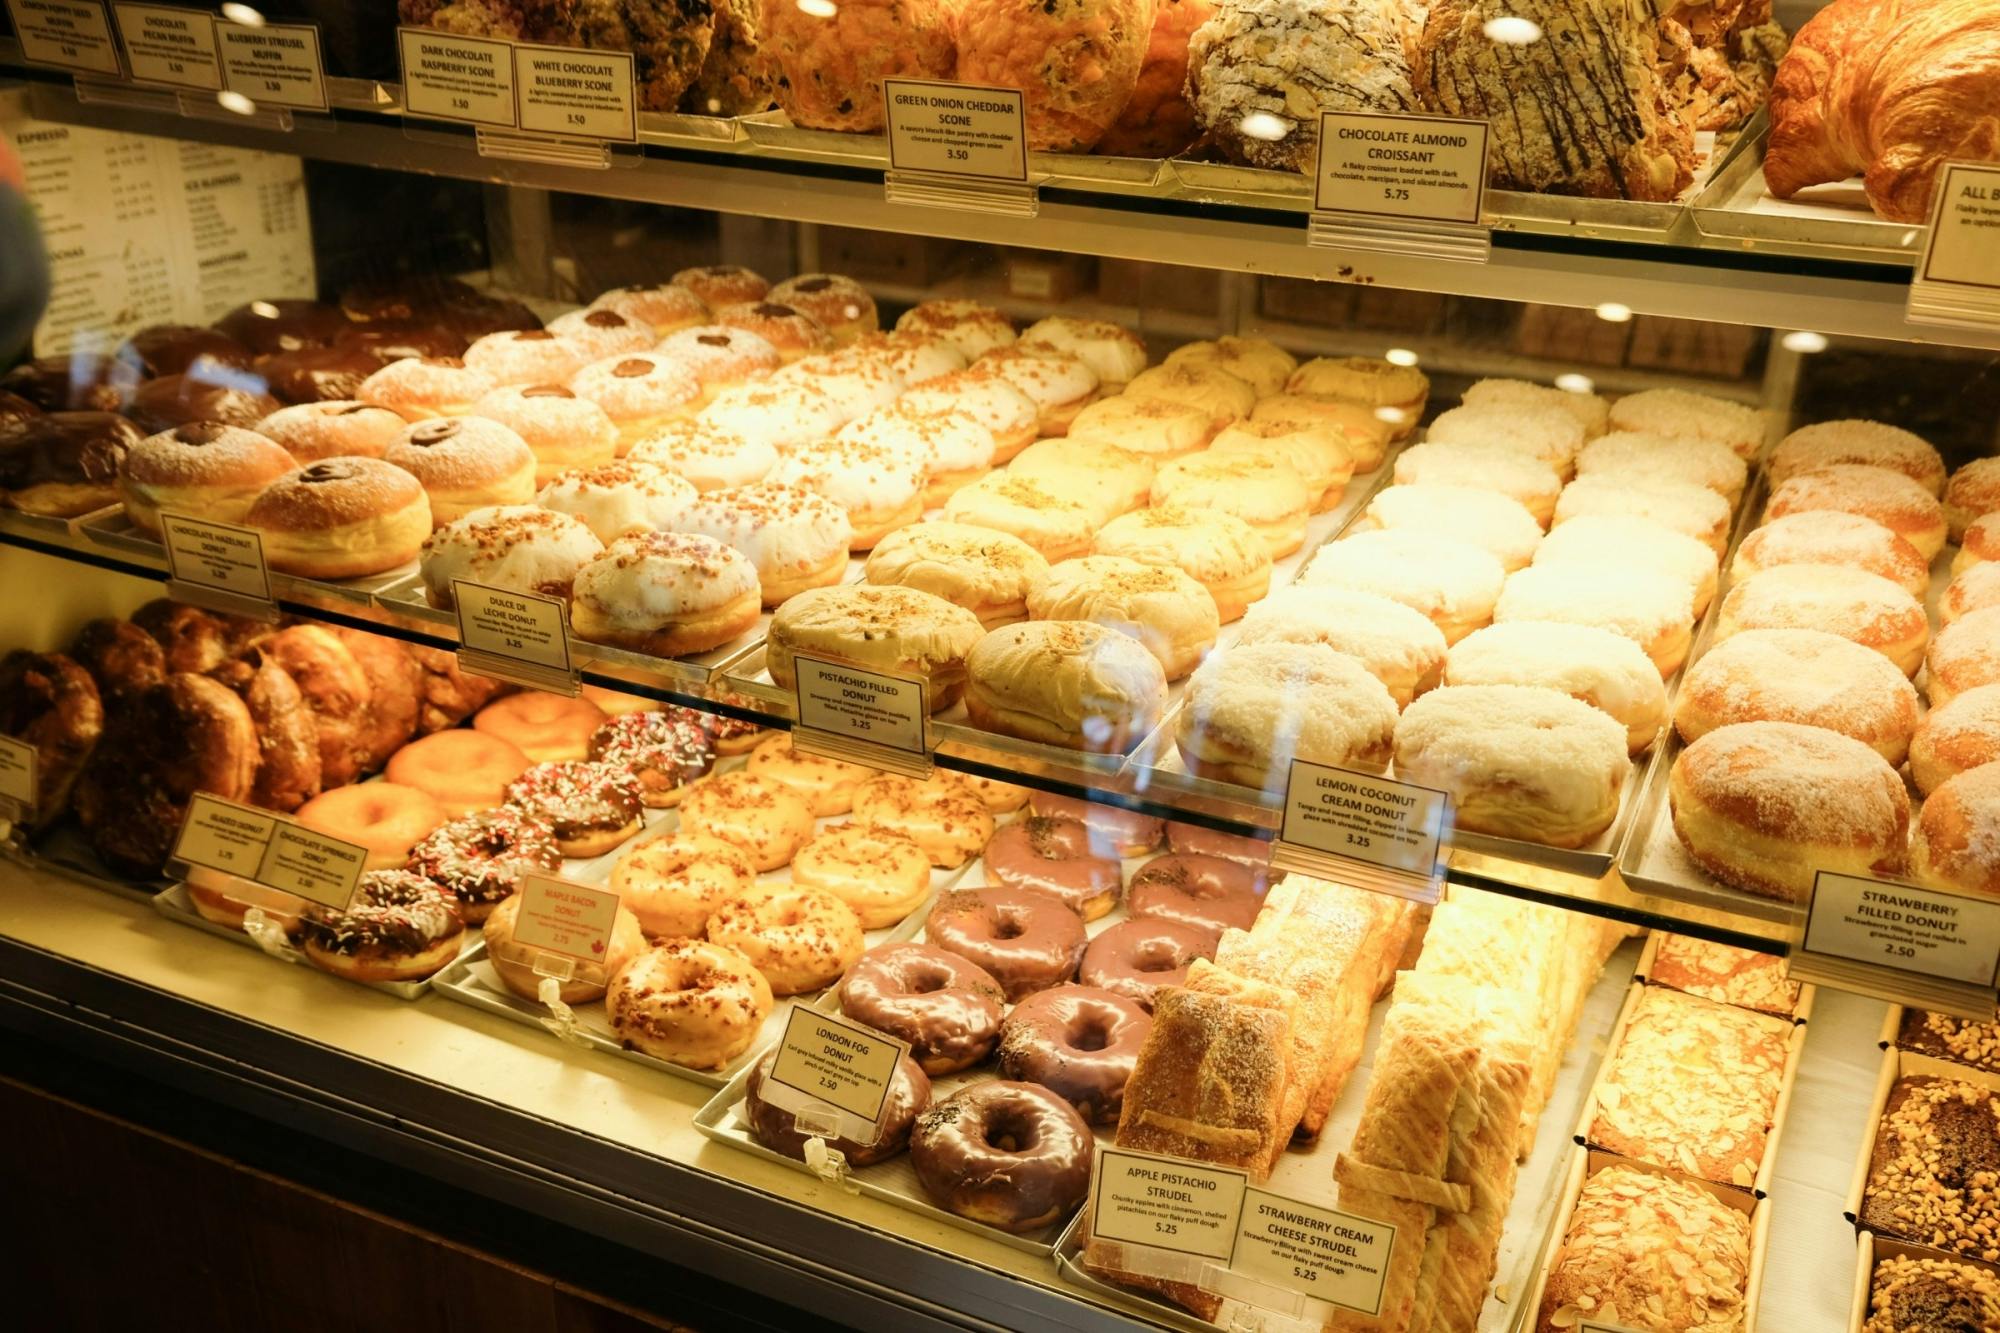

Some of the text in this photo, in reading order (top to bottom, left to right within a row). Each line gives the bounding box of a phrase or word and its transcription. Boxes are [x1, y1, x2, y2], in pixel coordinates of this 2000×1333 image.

[145, 16, 186, 30] CHOCOLATE
[143, 30, 196, 46] PECAN MUFFIN
[227, 32, 305, 49] BLUEBERRY STREUSEL
[252, 50, 282, 61] MUFFIN
[421, 45, 493, 63] DARK CHOCOLATE
[421, 59, 495, 78] RASPBERRY SCONE
[533, 61, 614, 76] WHITE CHOCOLATE
[535, 76, 612, 92] BLUEBERRY SCONE
[895, 94, 1014, 114] GREEN ONION CHEDDAR
[567, 114, 585, 124] 3.50
[939, 114, 972, 126] SCONE
[1339, 128, 1467, 147] CHOCOLATE ALMOND
[947, 149, 968, 160] 3.50
[1368, 148, 1435, 163] CROISSANT
[1349, 162, 1365, 171] flaky
[1367, 165, 1397, 173] croissant
[1400, 166, 1423, 175] loaded
[1425, 168, 1440, 176] with
[1441, 169, 1458, 177] dark
[1438, 180, 1468, 189] almonds
[1961, 186, 1987, 200] ALL
[1384, 188, 1409, 200] 5.75
[172, 525, 213, 540] CHOCOLATE
[489, 596, 527, 612] DULCE DE
[483, 608, 536, 626] LECHE DONUT
[506, 638, 522, 648] 3.25
[819, 671, 898, 696] PISTACHIO FILLED
[842, 689, 876, 703] DONUT
[851, 718, 871, 730] 3.25
[1316, 777, 1417, 808] LEMON COCONUT
[1298, 802, 1317, 812] Tangy
[1318, 807, 1331, 815] and
[1321, 793, 1407, 822] CREAM DONUT
[1337, 821, 1368, 833] shredded
[1369, 828, 1395, 839] coconut
[280, 831, 321, 850] CHOCOLATE
[1346, 833, 1370, 848] 3.25
[1863, 890, 1958, 917] STRAWBERRY
[1857, 905, 1958, 932] FILLED DONUT
[1844, 916, 1888, 931] Strawberry
[1890, 925, 1913, 936] filling
[1932, 932, 1957, 944] rolled
[1870, 931, 1938, 948] granulated sugar
[1885, 943, 1915, 958] 2.50
[816, 1027, 870, 1055] LONDON FOG
[824, 1045, 853, 1063] DONUT
[819, 1077, 837, 1090] 2.50
[1127, 1167, 1216, 1191] APPLE PISTACHIO
[1147, 1186, 1193, 1203] STRUDEL
[1112, 1194, 1134, 1204] Chunky
[1135, 1198, 1155, 1208] apples
[1156, 1202, 1170, 1210] with
[1205, 1210, 1227, 1220] shelled
[1117, 1205, 1147, 1216] pistachios
[1170, 1213, 1184, 1223] flaky
[1186, 1216, 1199, 1224] puff
[1200, 1218, 1219, 1229] dough
[1258, 1204, 1374, 1245] STRAWBERRY CREAM
[1155, 1222, 1177, 1235] 5.25
[1268, 1223, 1358, 1258] CHEESE STRUDEL
[1244, 1230, 1378, 1275] Strawberry filling with sweet cream cheese
[1281, 1252, 1292, 1260] our
[1293, 1255, 1309, 1266] flaky
[1309, 1259, 1324, 1270] puff
[1324, 1264, 1345, 1276] dough
[1293, 1266, 1317, 1282] 5.25
